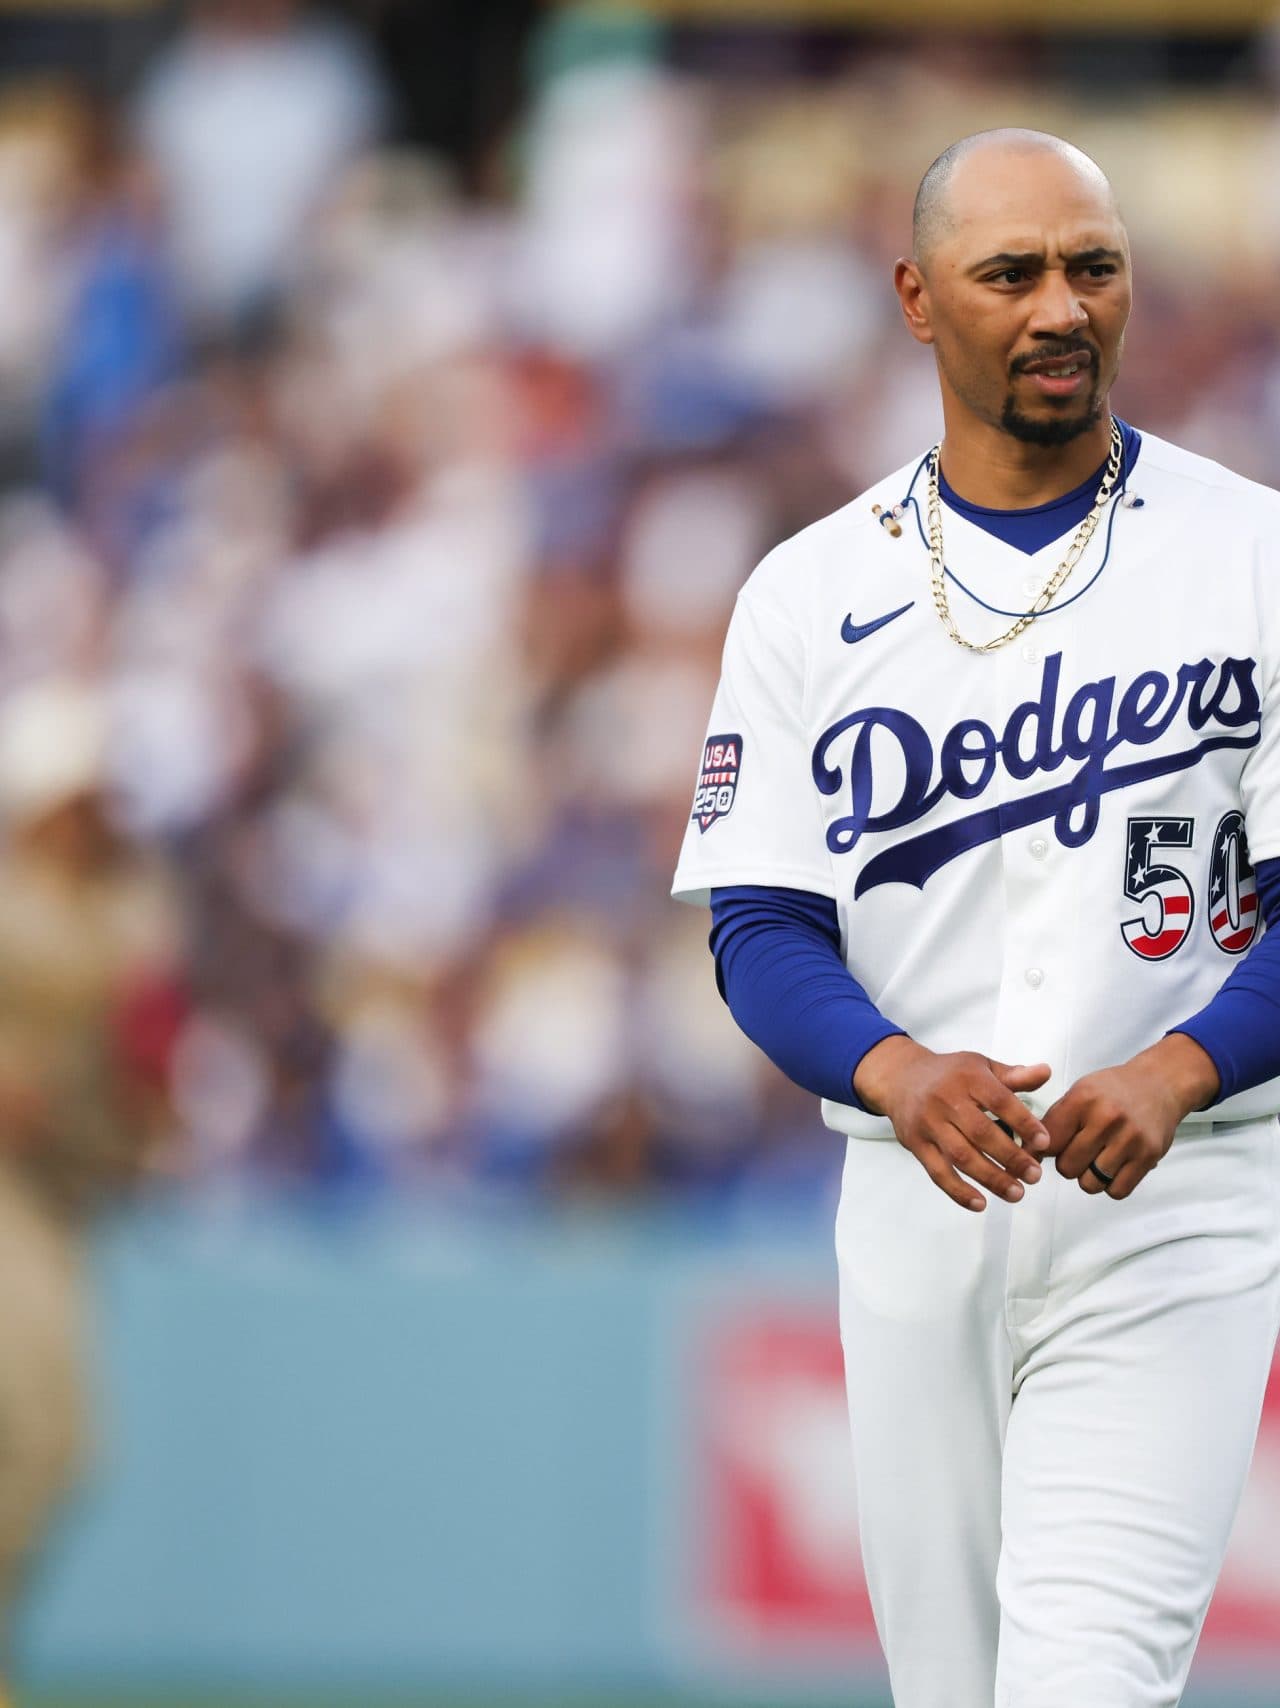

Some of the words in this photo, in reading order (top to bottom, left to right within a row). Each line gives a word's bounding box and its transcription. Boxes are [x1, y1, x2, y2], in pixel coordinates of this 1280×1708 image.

[704, 743, 737, 769] USA
[811, 651, 1262, 854] Dodgers
[695, 786, 734, 813] 250
[1120, 809, 1260, 962] 50
